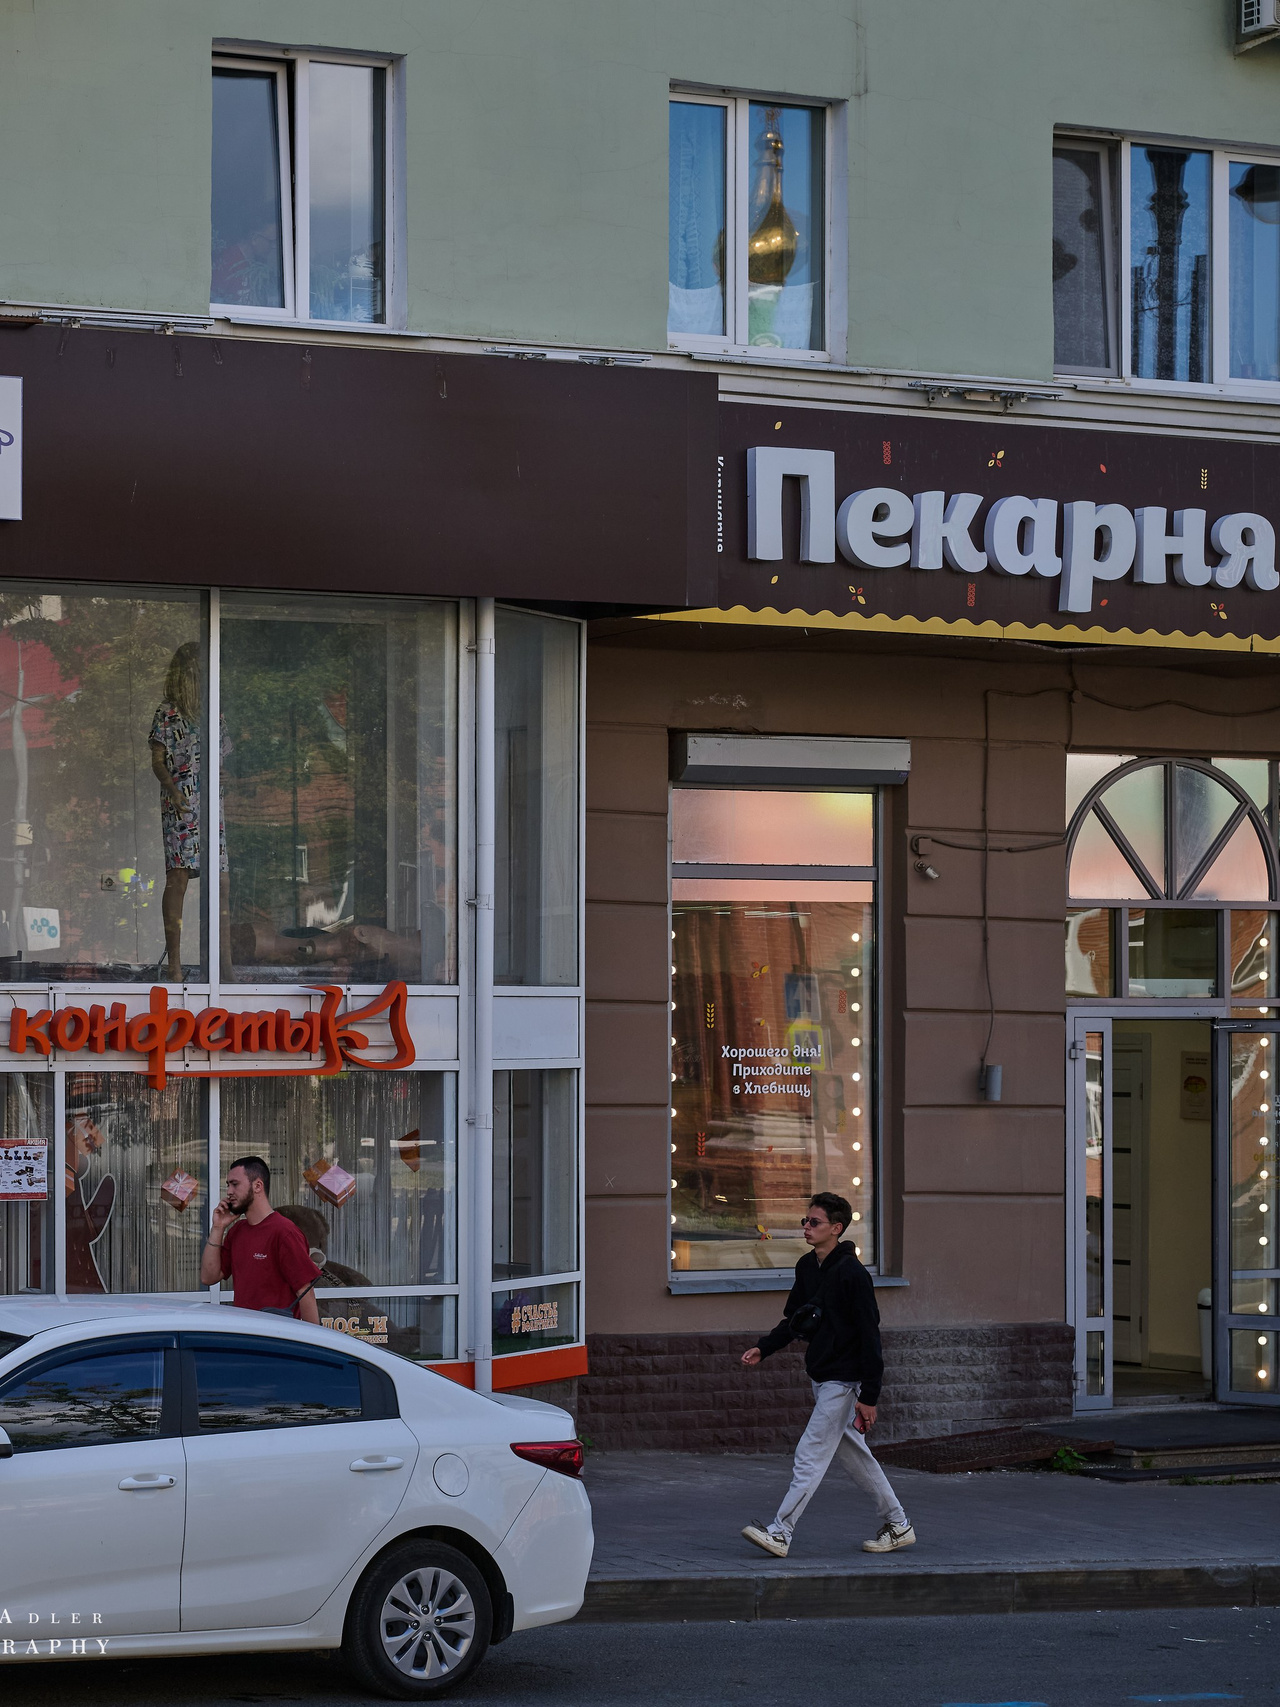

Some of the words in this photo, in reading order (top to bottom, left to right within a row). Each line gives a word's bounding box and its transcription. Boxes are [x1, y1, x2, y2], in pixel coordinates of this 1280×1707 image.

[746, 446, 1280, 613] Пекарня
[8, 986, 321, 1091] конфеты
[721, 1045, 789, 1061] Хорошего
[793, 1044, 822, 1057] дня!
[732, 1063, 811, 1079] Приходите
[733, 1084, 740, 1094] в
[744, 1081, 811, 1097] Хлебницу
